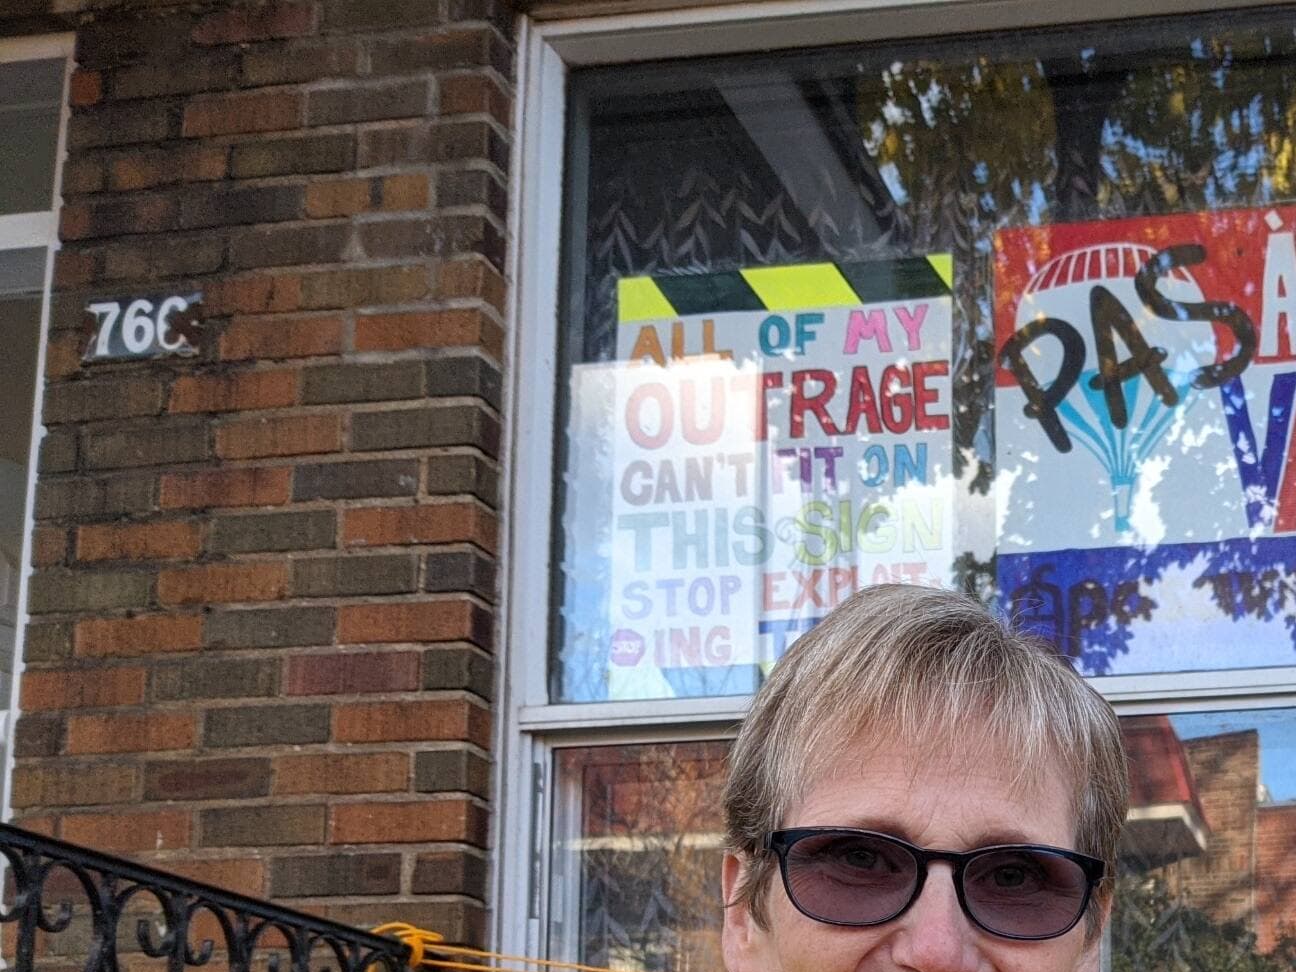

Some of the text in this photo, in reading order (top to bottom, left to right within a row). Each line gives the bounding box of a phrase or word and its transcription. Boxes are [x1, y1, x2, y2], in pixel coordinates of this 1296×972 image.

[627, 304, 929, 367] ALL OF MY
[1000, 244, 1256, 452] PAS
[625, 360, 950, 450] OUTRAGE
[620, 443, 928, 506] CAN'T FIT ON
[617, 499, 944, 573] THIS SIGN
[621, 575, 742, 620] STOP
[654, 626, 732, 668] ING
